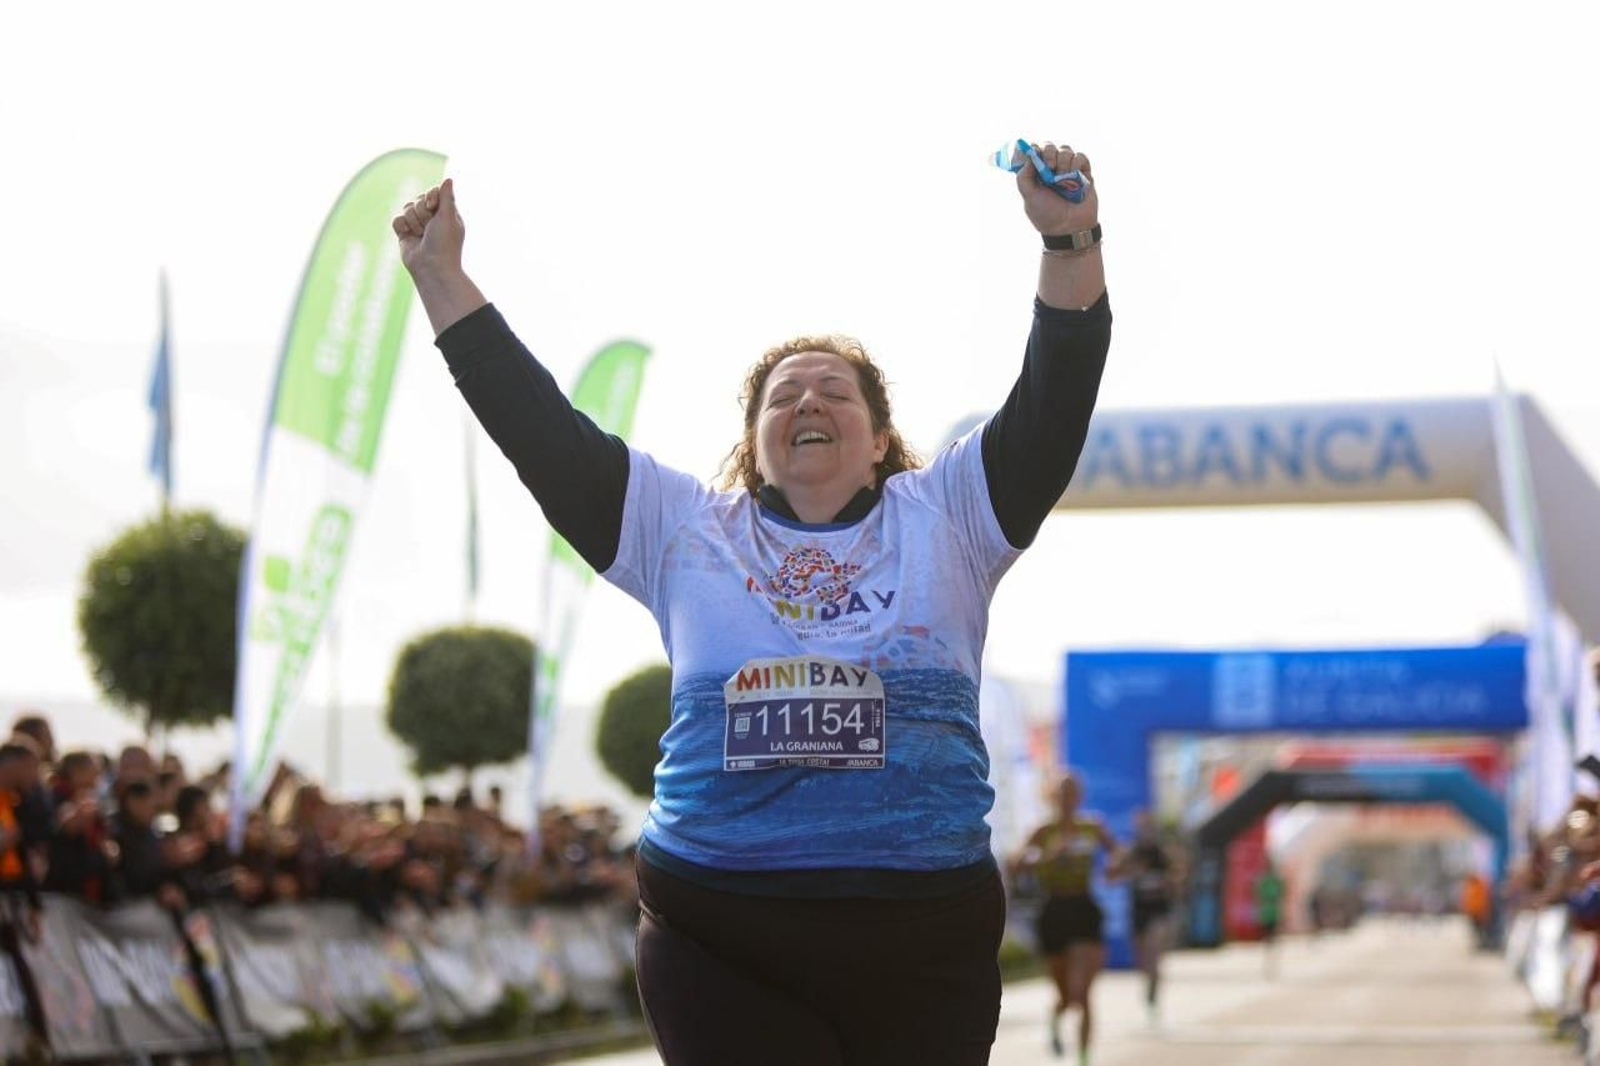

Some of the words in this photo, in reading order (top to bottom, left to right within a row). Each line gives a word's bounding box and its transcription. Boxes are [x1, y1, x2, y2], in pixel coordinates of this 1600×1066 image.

[1083, 416, 1428, 487] ABANCA
[736, 662, 868, 691] MINIBAY
[756, 703, 865, 736] 11154
[770, 741, 785, 752] LA
[786, 741, 843, 752] GRANIANA
